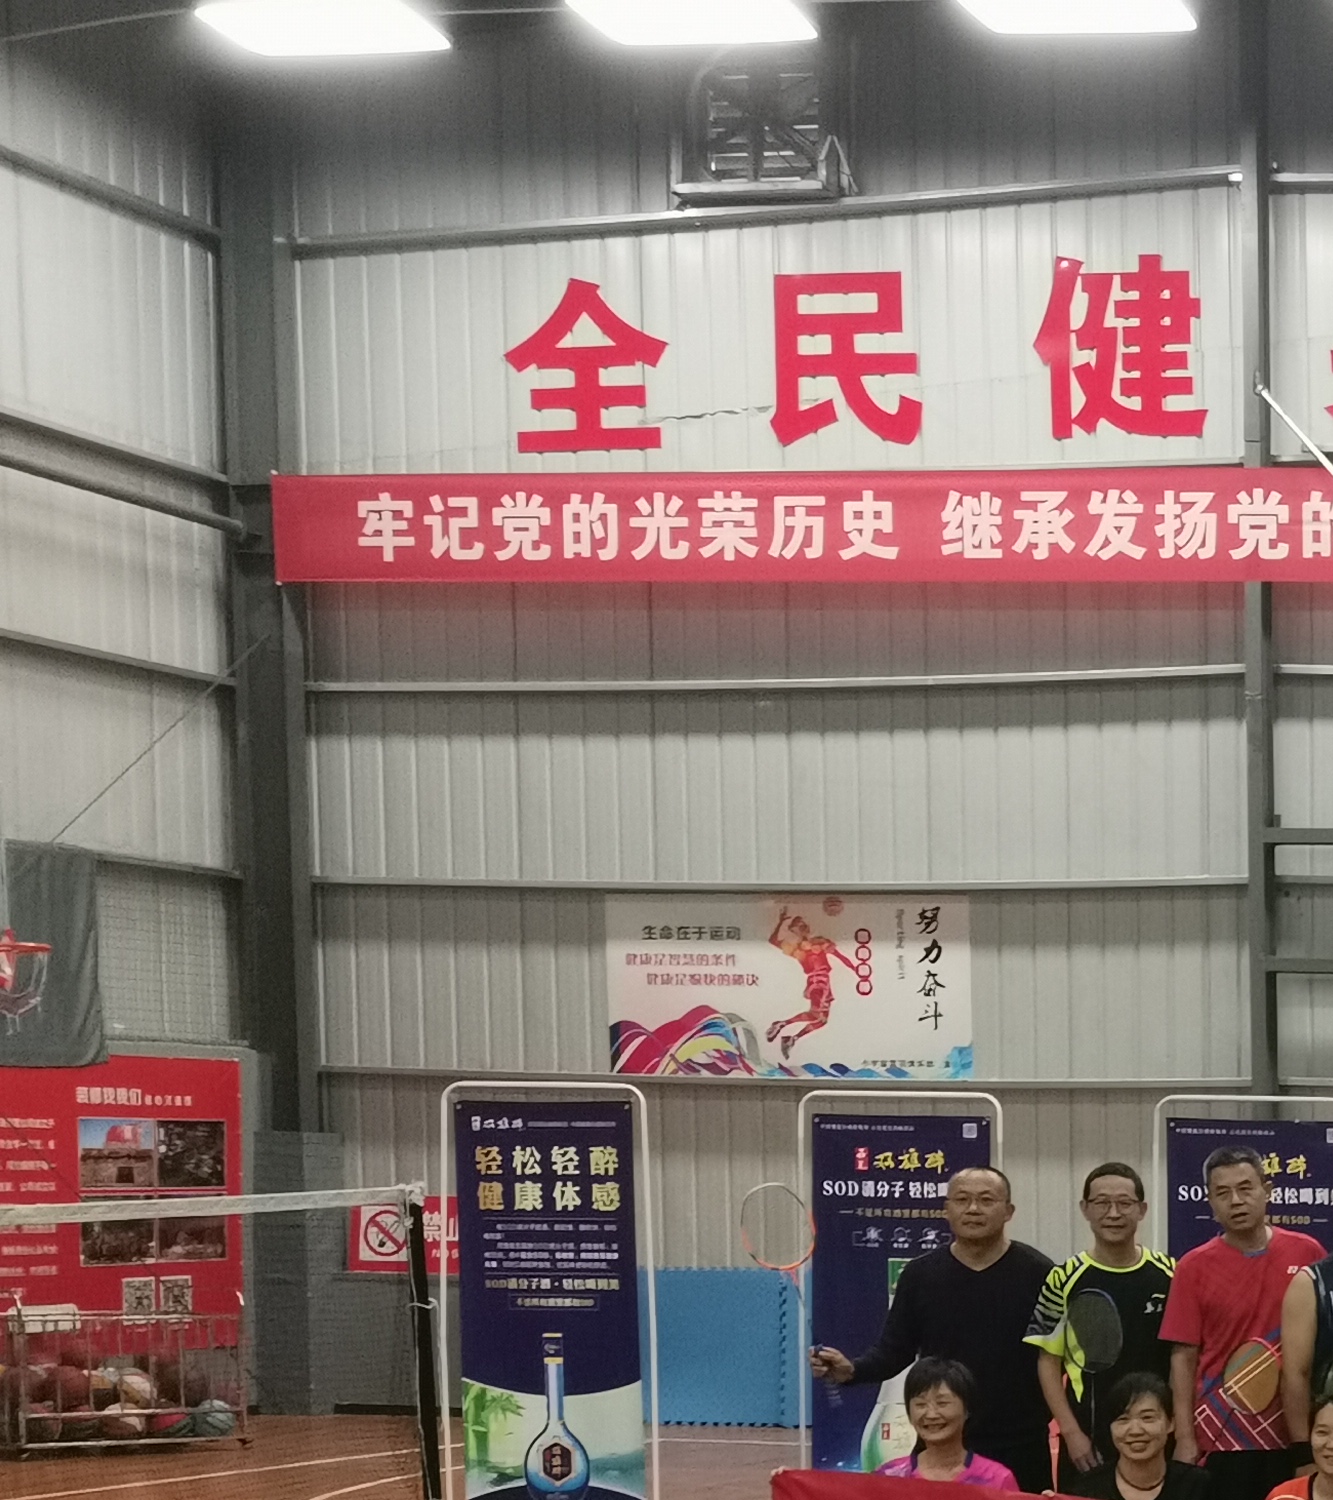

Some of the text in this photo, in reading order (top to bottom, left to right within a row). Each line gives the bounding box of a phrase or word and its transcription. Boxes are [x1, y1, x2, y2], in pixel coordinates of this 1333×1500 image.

[357, 490, 901, 562] 牢记党的光荣历史
[641, 925, 742, 941] 生命在于运动
[474, 1145, 620, 1176] 轻松轻醉
[476, 1181, 622, 1211] 健康体感
